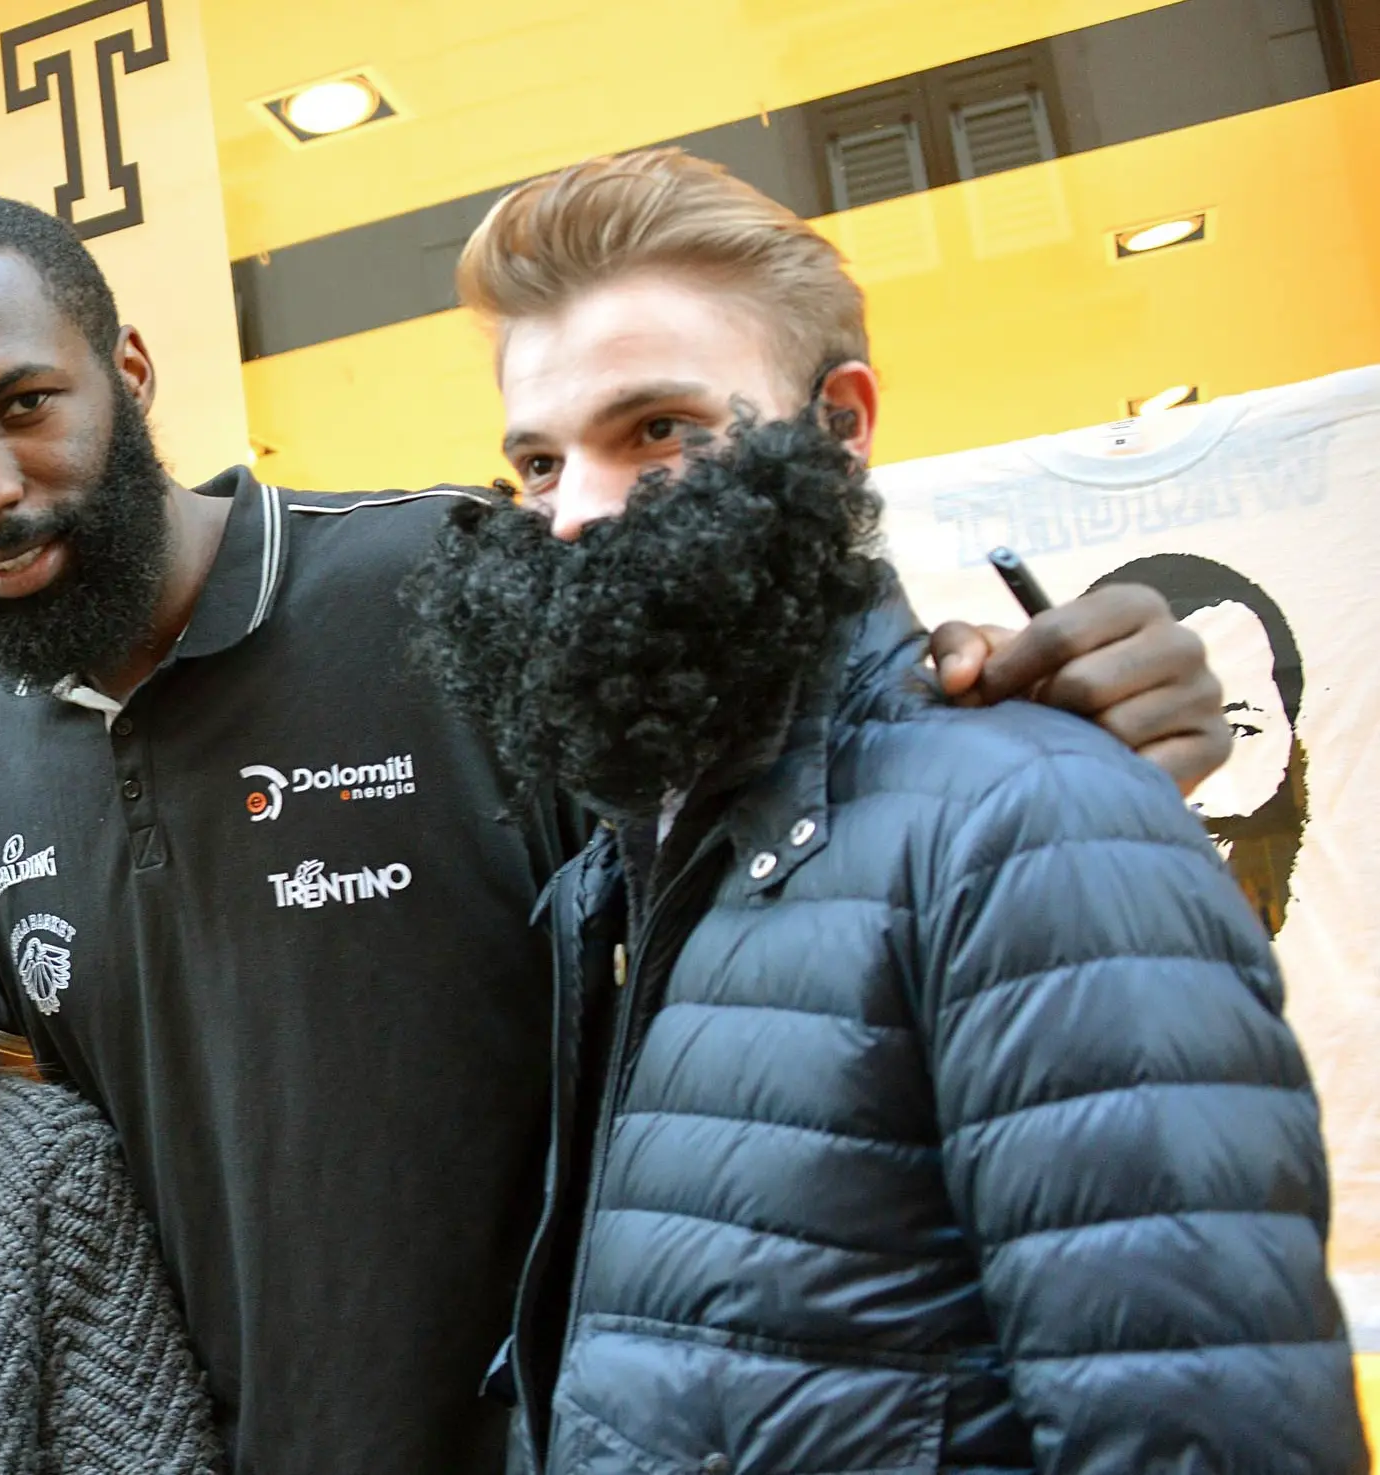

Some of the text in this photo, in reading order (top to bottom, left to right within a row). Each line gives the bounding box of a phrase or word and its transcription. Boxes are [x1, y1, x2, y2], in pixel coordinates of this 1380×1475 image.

[291, 754, 414, 793] Dolomiti
[339, 781, 417, 801] energia
[267, 862, 413, 909] TRENTINO
